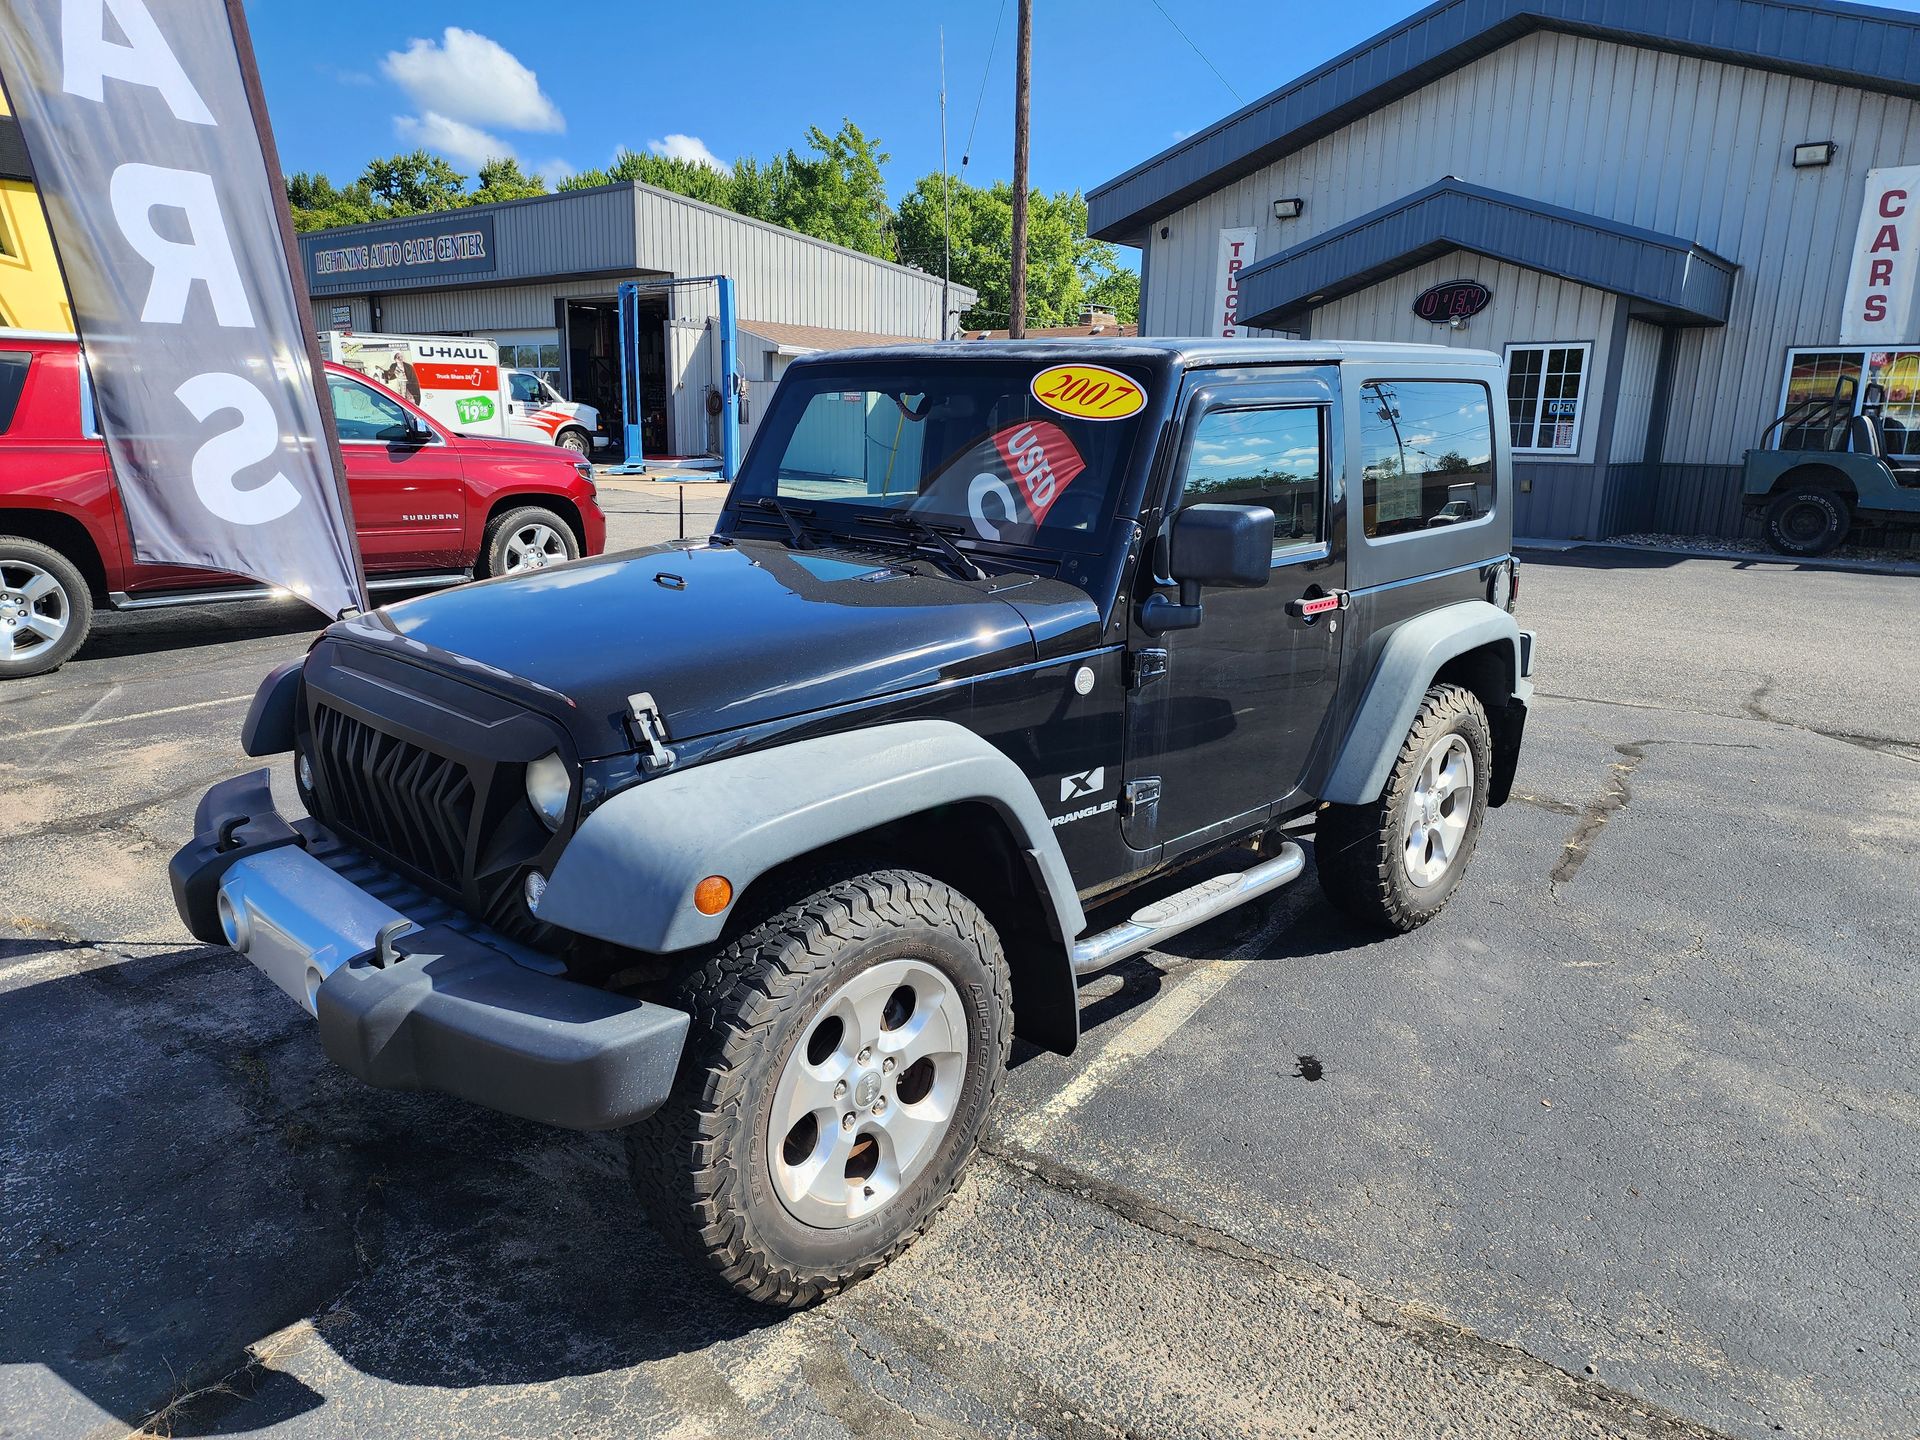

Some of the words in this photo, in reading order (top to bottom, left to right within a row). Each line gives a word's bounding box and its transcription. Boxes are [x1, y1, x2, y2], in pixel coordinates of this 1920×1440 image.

[315, 246, 368, 274] LIGHTNING
[370, 243, 401, 269] AUTO
[402, 237, 435, 266] CARE
[435, 231, 486, 261] CENTER
[1863, 189, 1908, 322] CARS
[419, 346, 489, 359] U-HAUL
[1040, 373, 1136, 410] 2007
[1551, 403, 1576, 413] OPEN
[1007, 424, 1056, 508] USED
[402, 513, 459, 521] SUBURBAN
